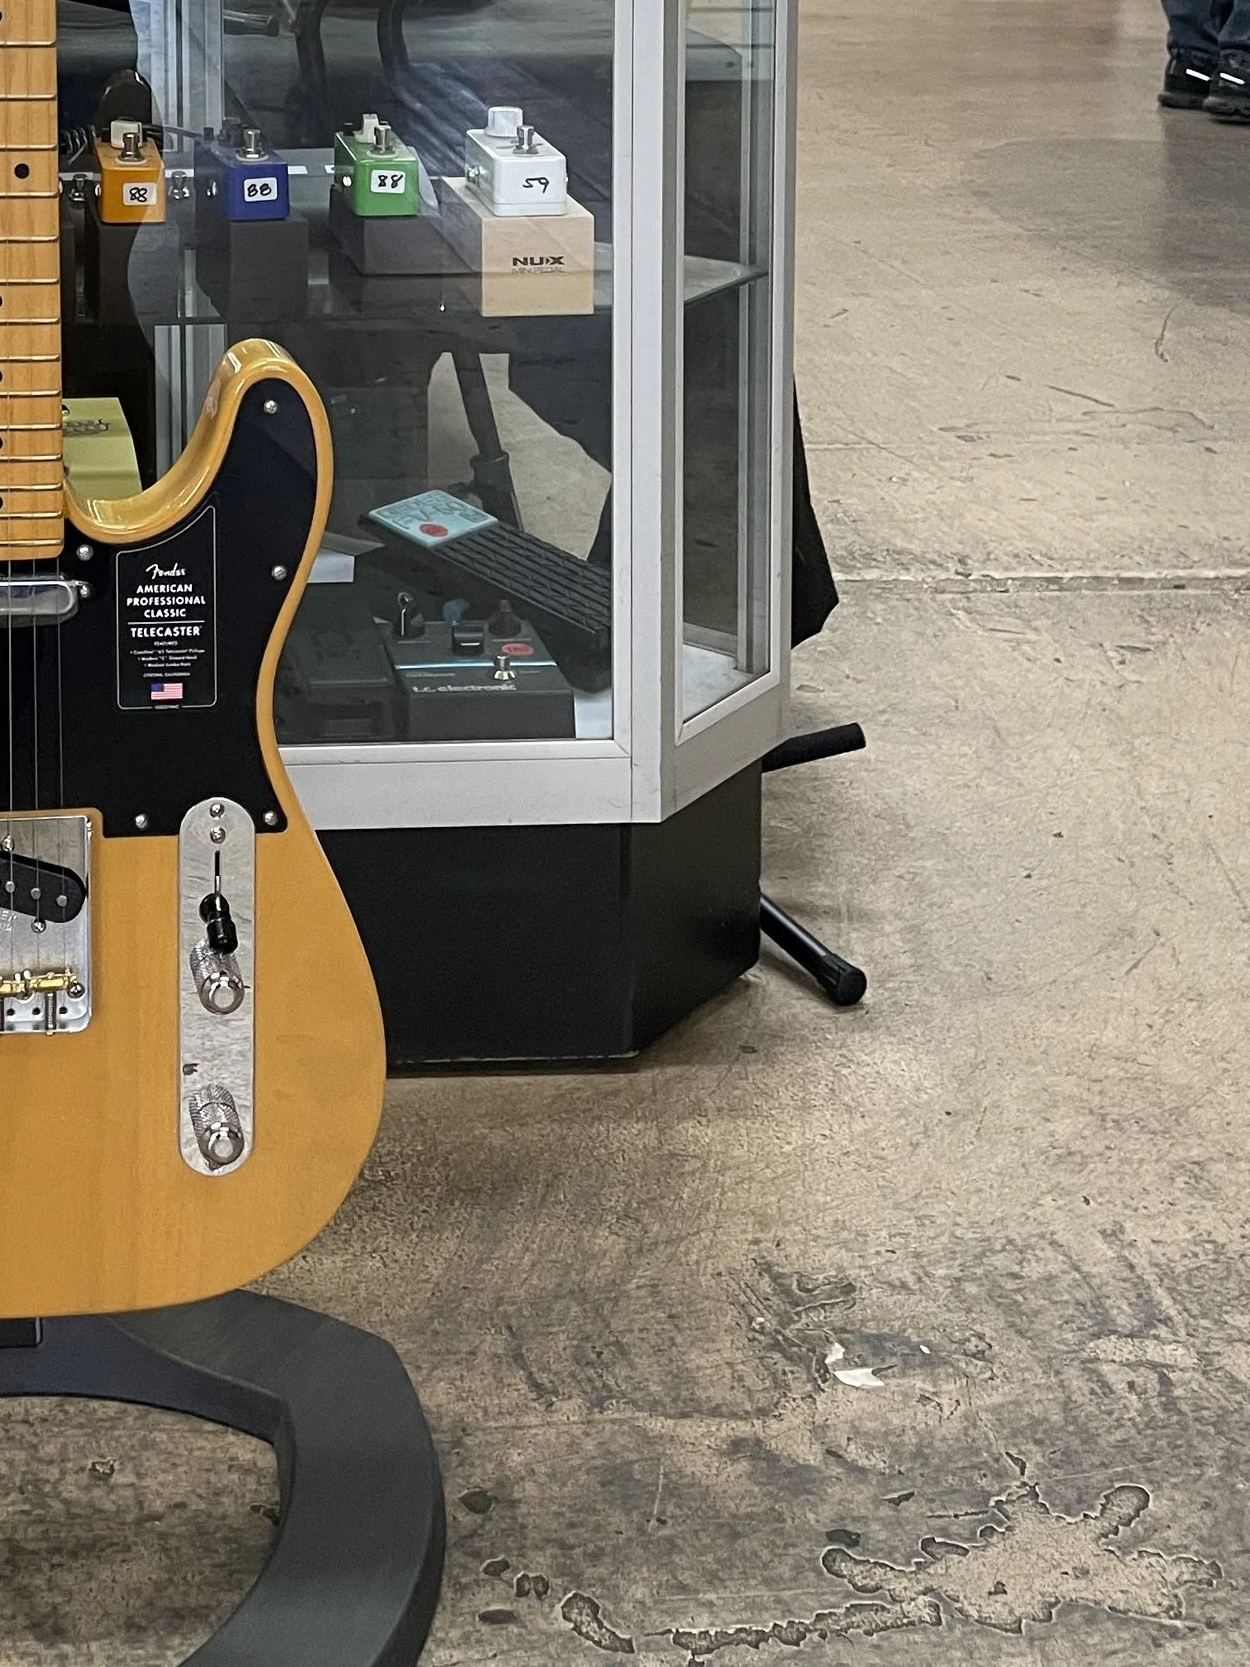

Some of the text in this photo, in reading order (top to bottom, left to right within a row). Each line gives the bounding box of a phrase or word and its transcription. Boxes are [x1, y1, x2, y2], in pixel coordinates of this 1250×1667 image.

[377, 174, 404, 189] 88
[522, 177, 550, 194] 59
[129, 186, 148, 203] 88
[247, 183, 272, 198] 88
[512, 255, 565, 266] NUX
[145, 562, 187, 580] Fender
[136, 584, 193, 594] AMERICAN
[126, 595, 207, 606] PROFESSIONAL
[143, 608, 187, 618] CLASSIC
[130, 625, 200, 638] TELECASTER
